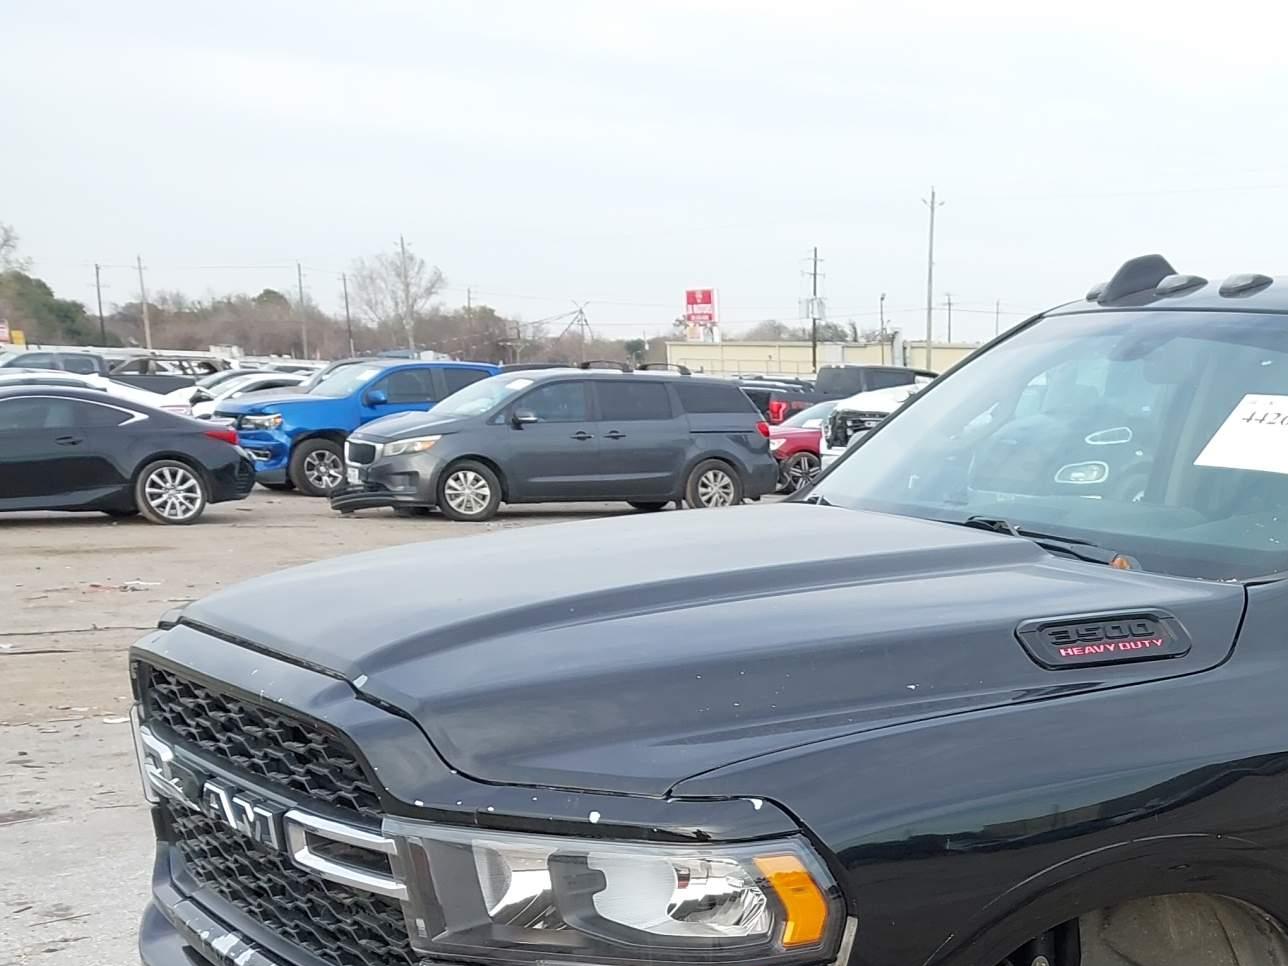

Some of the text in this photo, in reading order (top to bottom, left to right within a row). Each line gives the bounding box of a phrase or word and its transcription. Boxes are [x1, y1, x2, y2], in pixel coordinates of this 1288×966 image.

[1047, 621, 1155, 646] 3500
[1059, 639, 1164, 657] HEAVY DUTY
